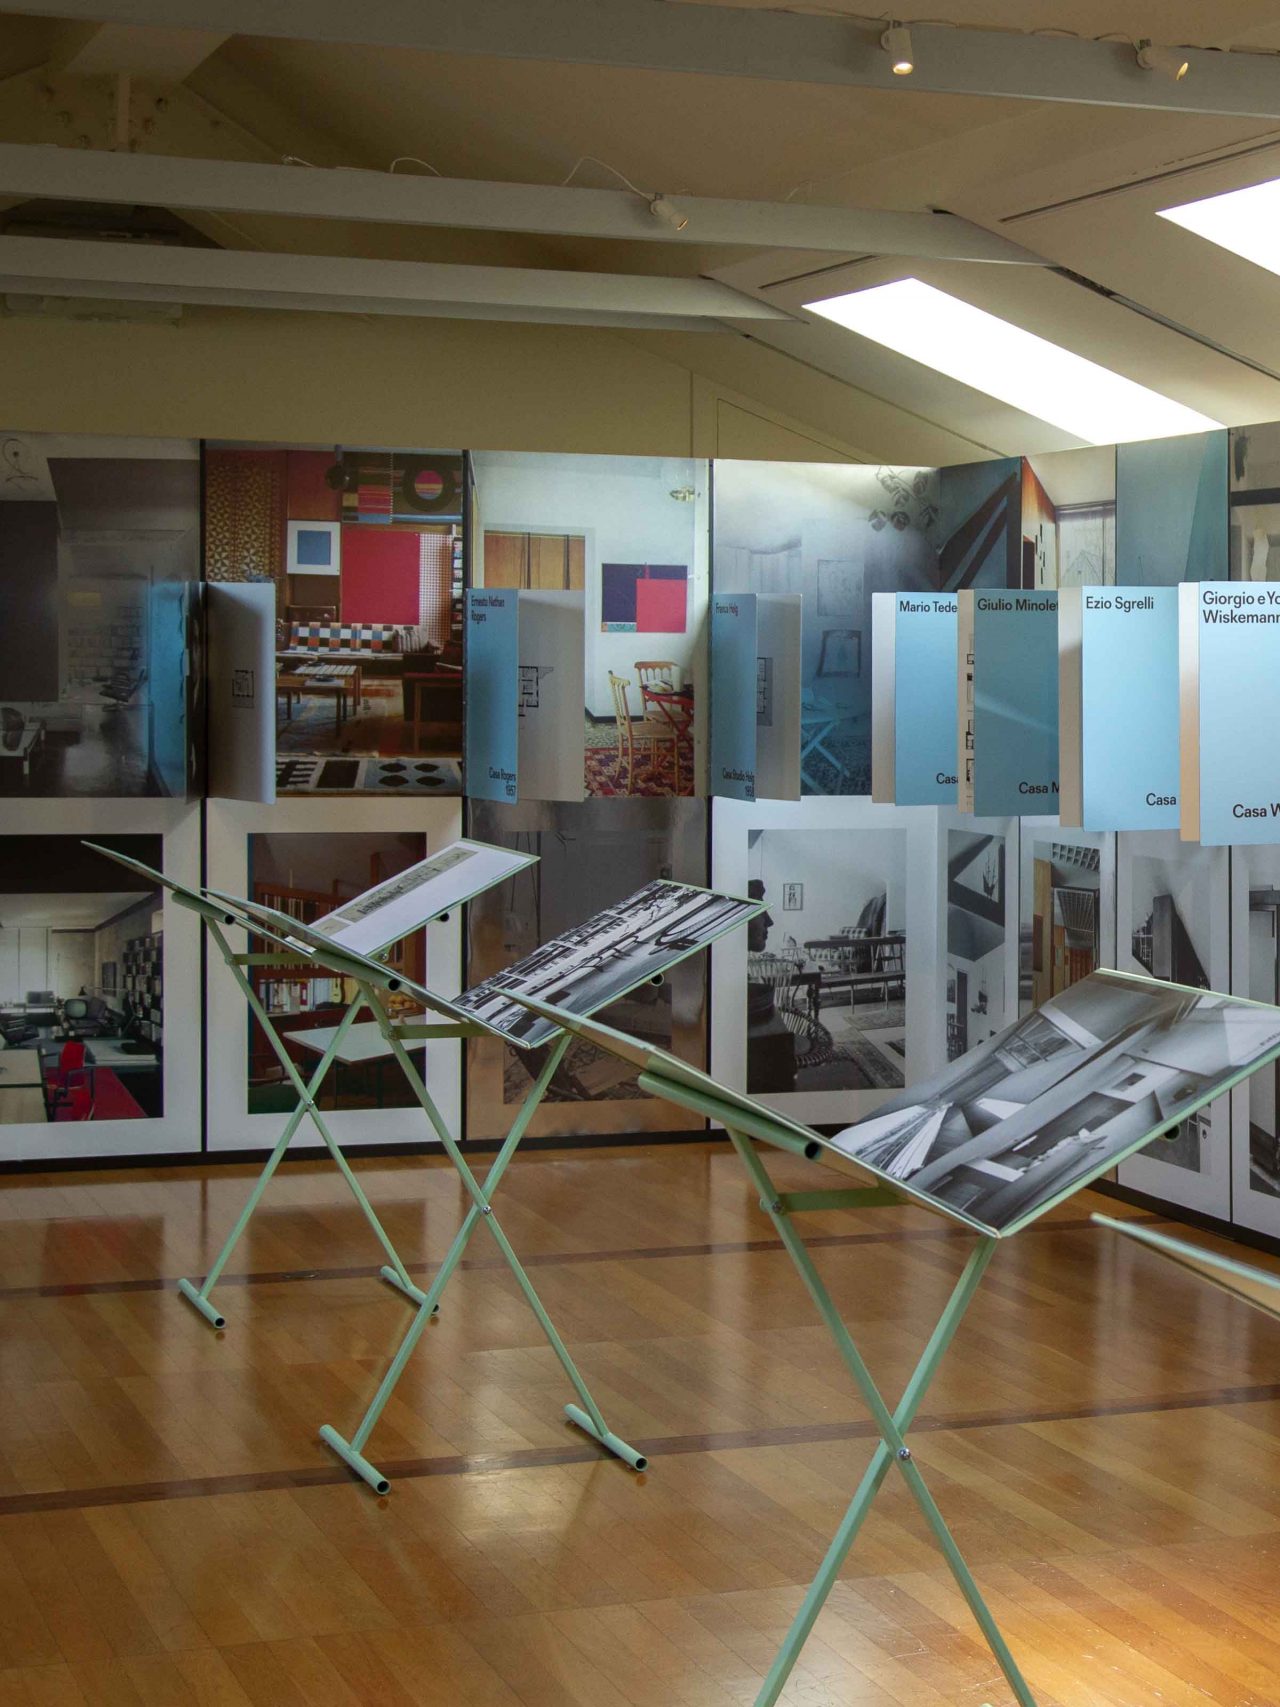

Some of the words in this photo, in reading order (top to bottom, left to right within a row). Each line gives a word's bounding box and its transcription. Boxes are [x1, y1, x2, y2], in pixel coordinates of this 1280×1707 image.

[900, 601, 930, 612] Mario
[978, 598, 1012, 610] Giulio
[1087, 596, 1111, 609] Ezio
[1115, 596, 1153, 612] Sgrelli
[1203, 591, 1254, 610] Giorgio
[1258, 596, 1265, 604] e
[1019, 782, 1048, 794] Casa
[1146, 793, 1176, 806] Casa
[1233, 804, 1267, 818] Casa
